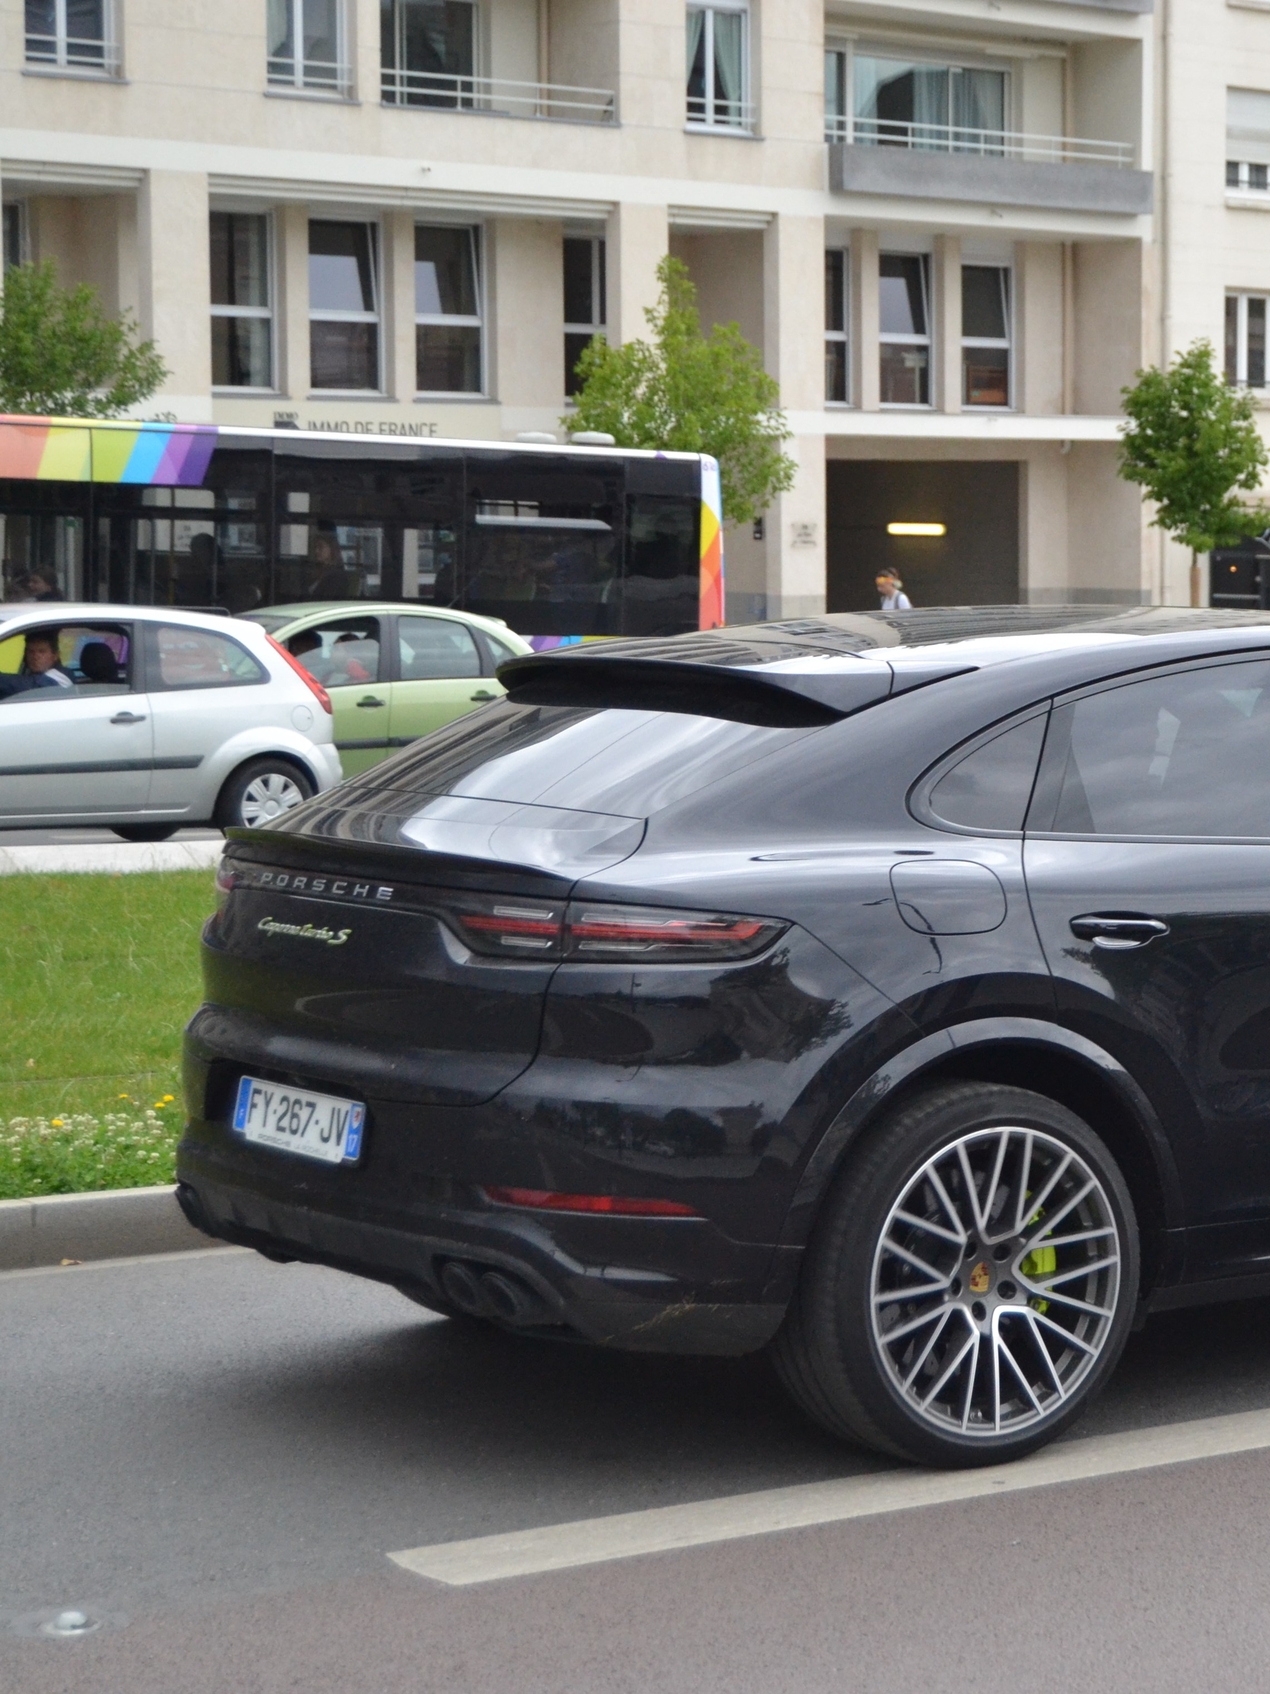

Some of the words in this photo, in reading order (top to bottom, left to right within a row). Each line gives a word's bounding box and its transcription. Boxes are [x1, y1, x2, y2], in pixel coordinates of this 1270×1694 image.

[308, 420, 350, 432] IMMO
[354, 422, 374, 434] DE
[379, 422, 439, 437] FRANCE
[260, 872, 394, 900] PORSCHE
[326, 928, 353, 945] S
[247, 1088, 349, 1147] FY-267-JV
